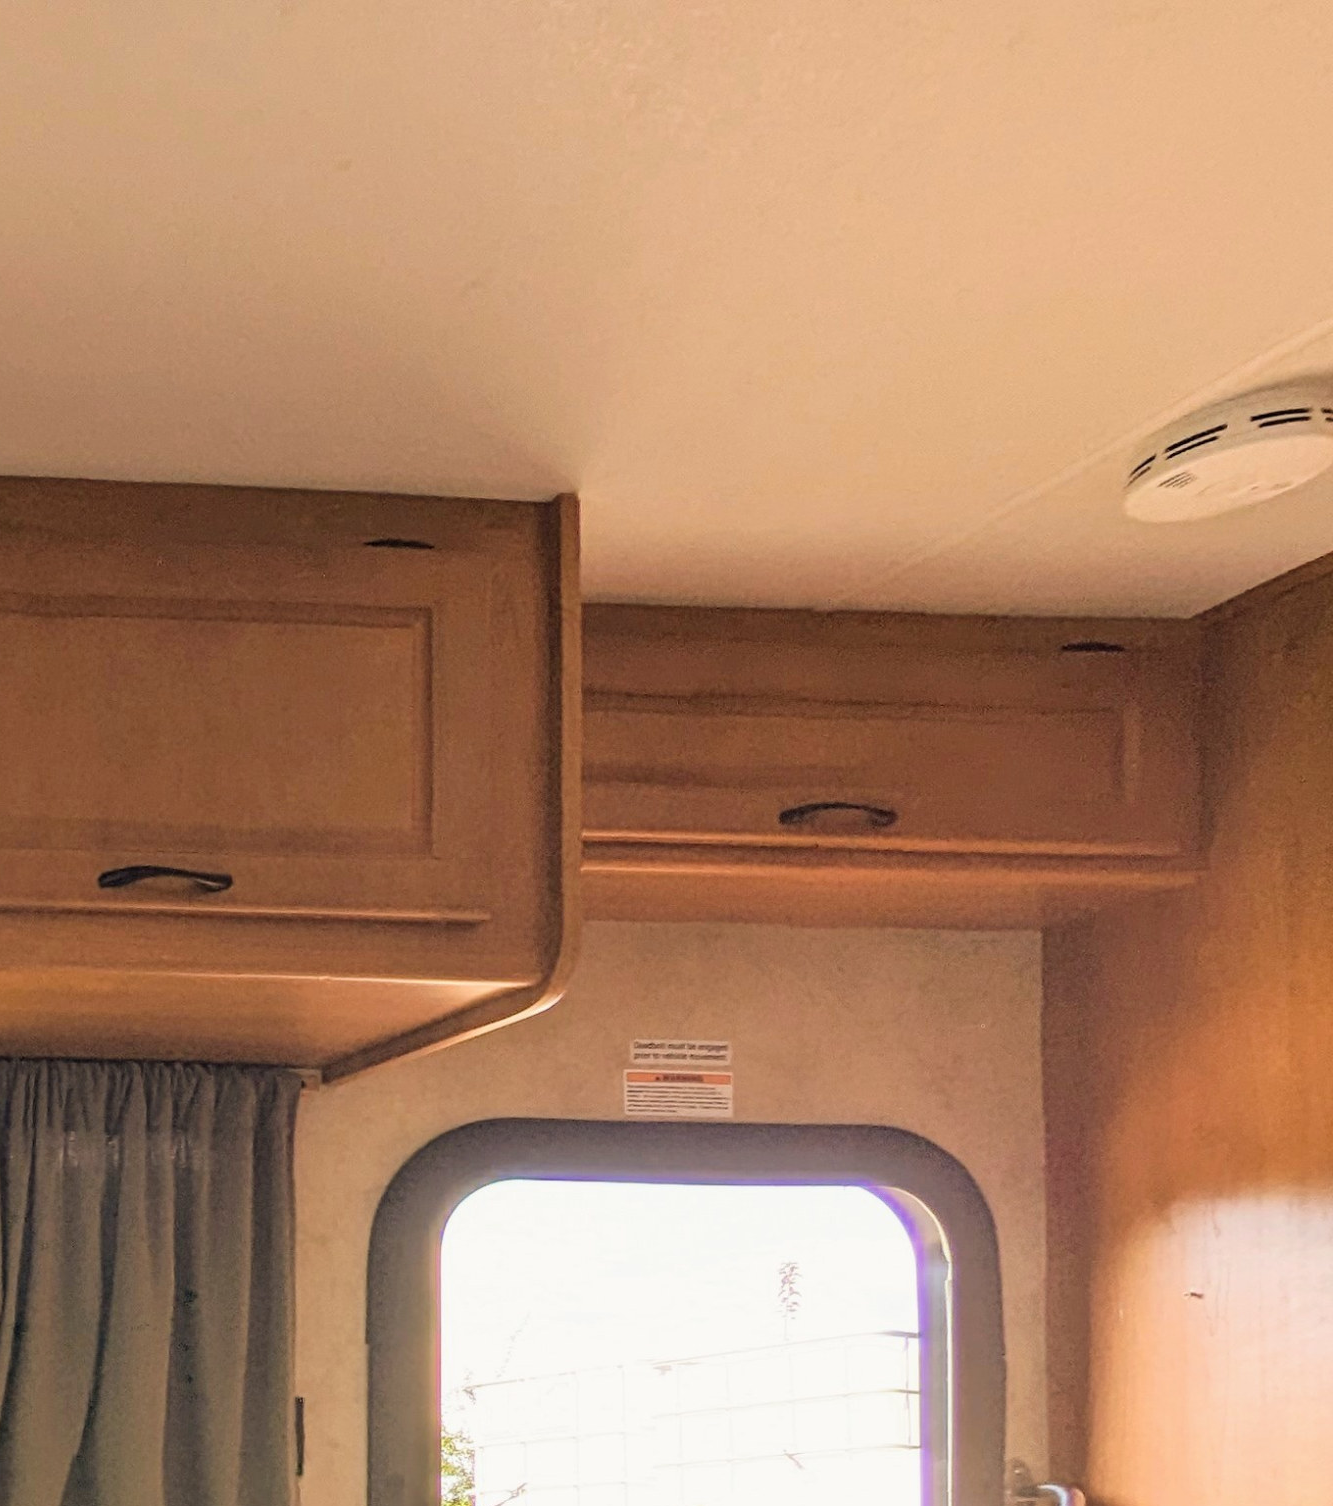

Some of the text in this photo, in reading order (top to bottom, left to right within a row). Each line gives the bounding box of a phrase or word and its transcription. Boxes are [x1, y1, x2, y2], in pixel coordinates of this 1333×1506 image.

[634, 1041, 665, 1050] Deadbolt
[688, 1042, 697, 1050] be
[653, 1052, 661, 1060] to
[663, 1052, 687, 1060] vehicle
